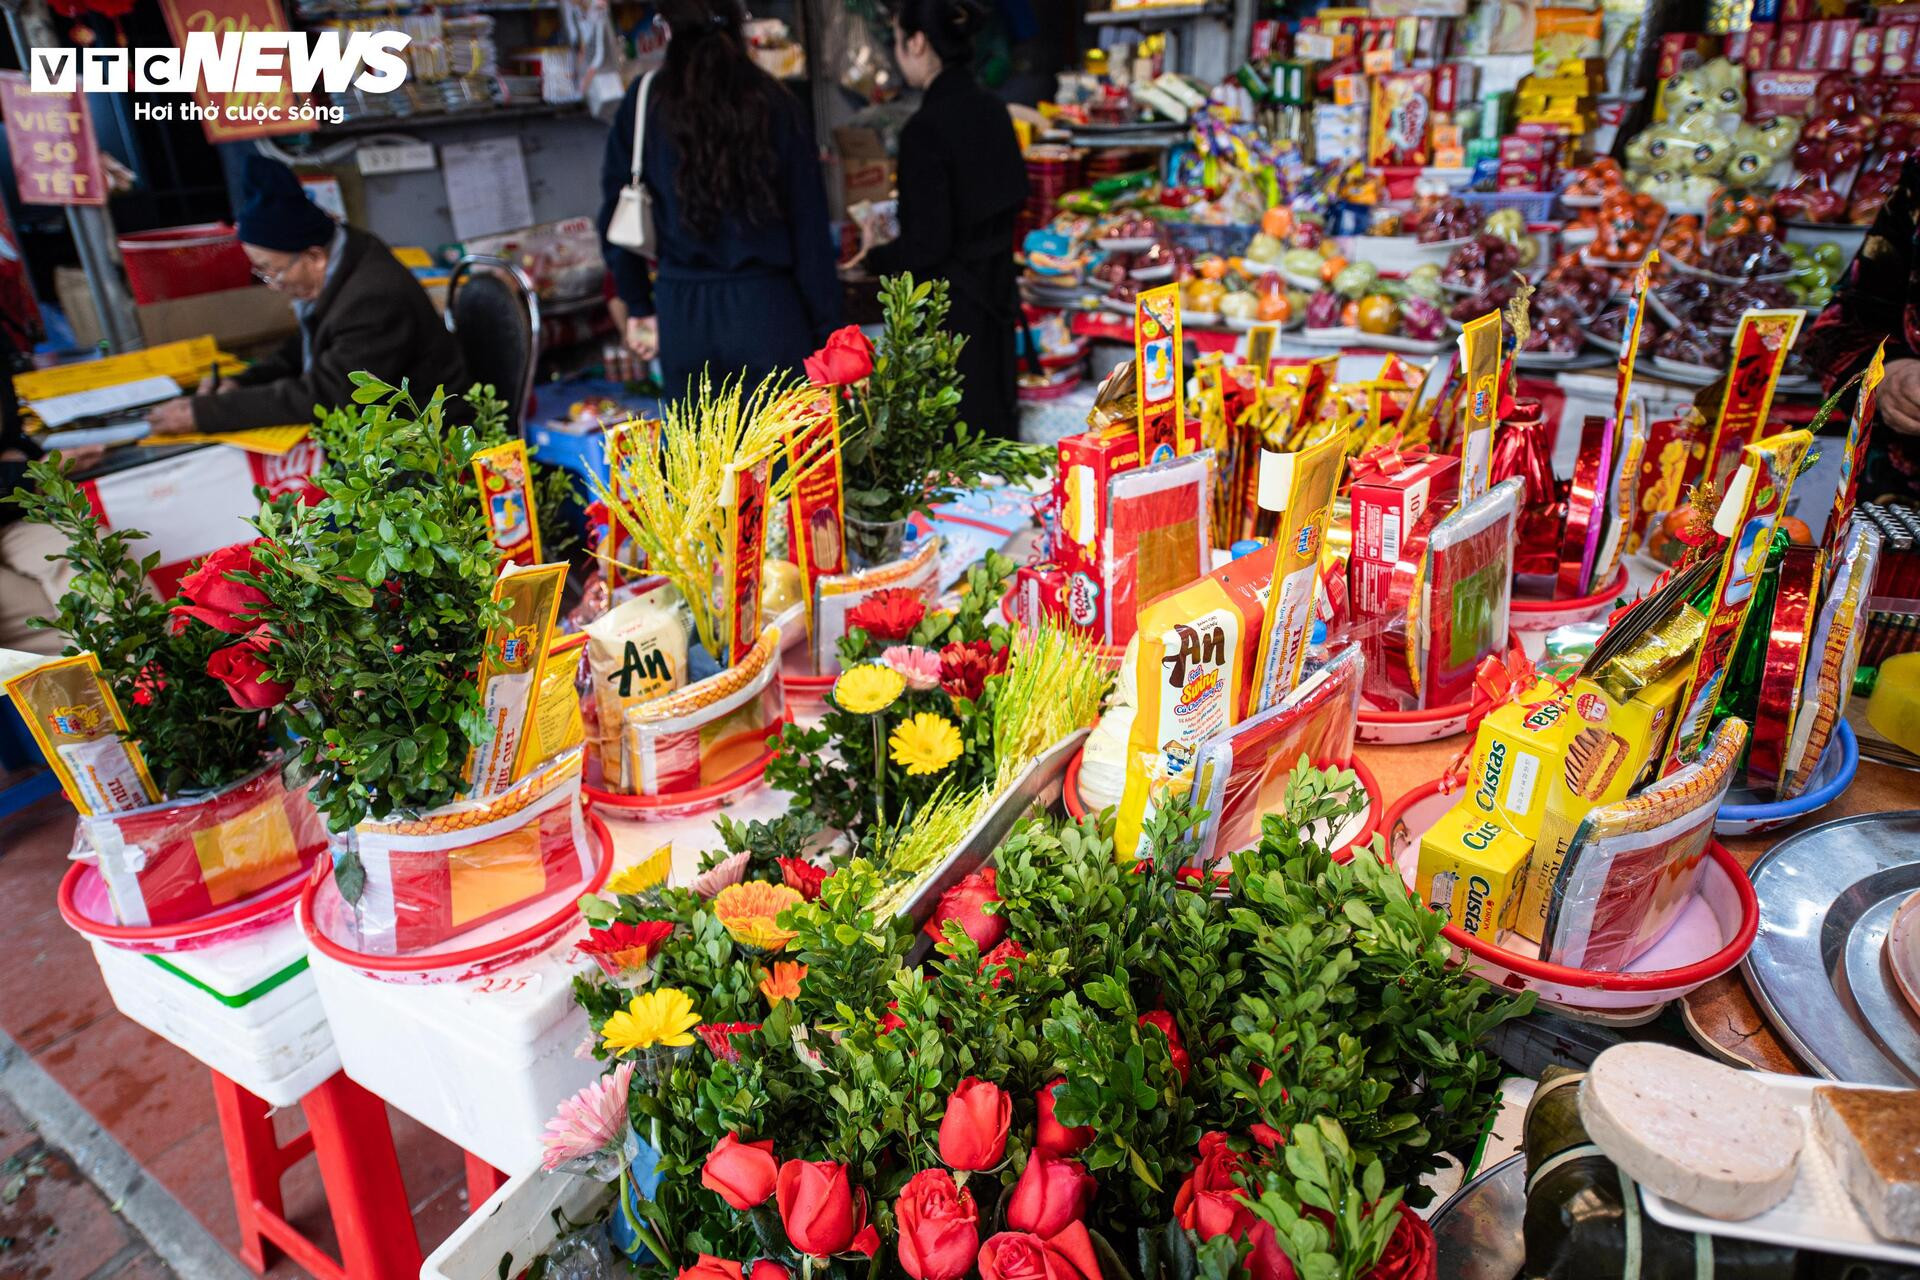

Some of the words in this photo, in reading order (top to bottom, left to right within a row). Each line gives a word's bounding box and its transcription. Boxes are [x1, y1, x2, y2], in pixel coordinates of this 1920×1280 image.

[1298, 526, 1312, 554] HTH
[504, 639, 518, 662] HTH
[1162, 624, 1226, 689] An
[607, 640, 672, 697] An
[1181, 669, 1219, 704] Swing
[1475, 739, 1507, 812] Custas
[1462, 821, 1501, 851] Cus
[1464, 875, 1491, 937] Custa
[1483, 905, 1495, 930] ORION
